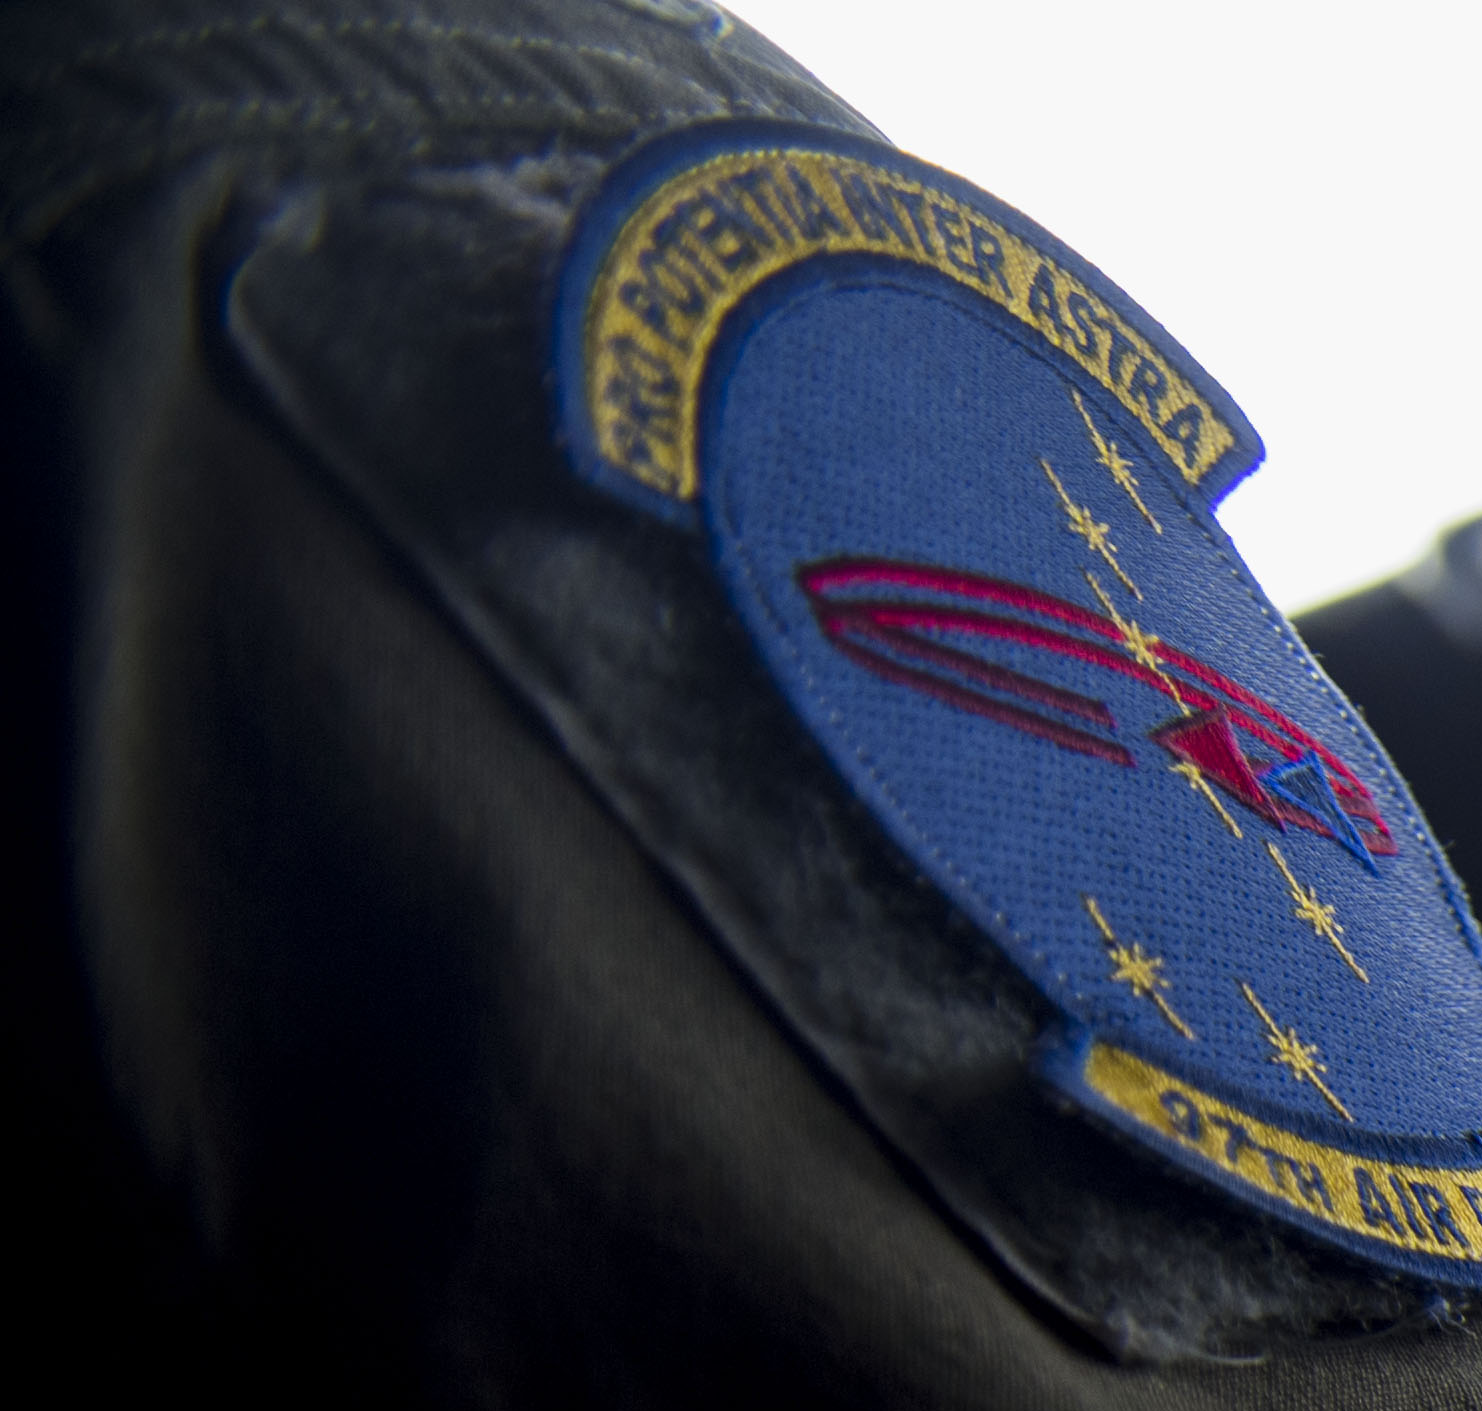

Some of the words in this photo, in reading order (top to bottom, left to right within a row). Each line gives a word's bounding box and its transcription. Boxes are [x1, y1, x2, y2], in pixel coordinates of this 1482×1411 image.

[619, 163, 846, 348] POTENTIA
[829, 167, 1013, 299] INTER
[606, 334, 683, 487] PRO
[1029, 264, 1203, 468] ASTRA
[1159, 1090, 1334, 1212] 97TH
[1353, 1166, 1468, 1247] AIR
